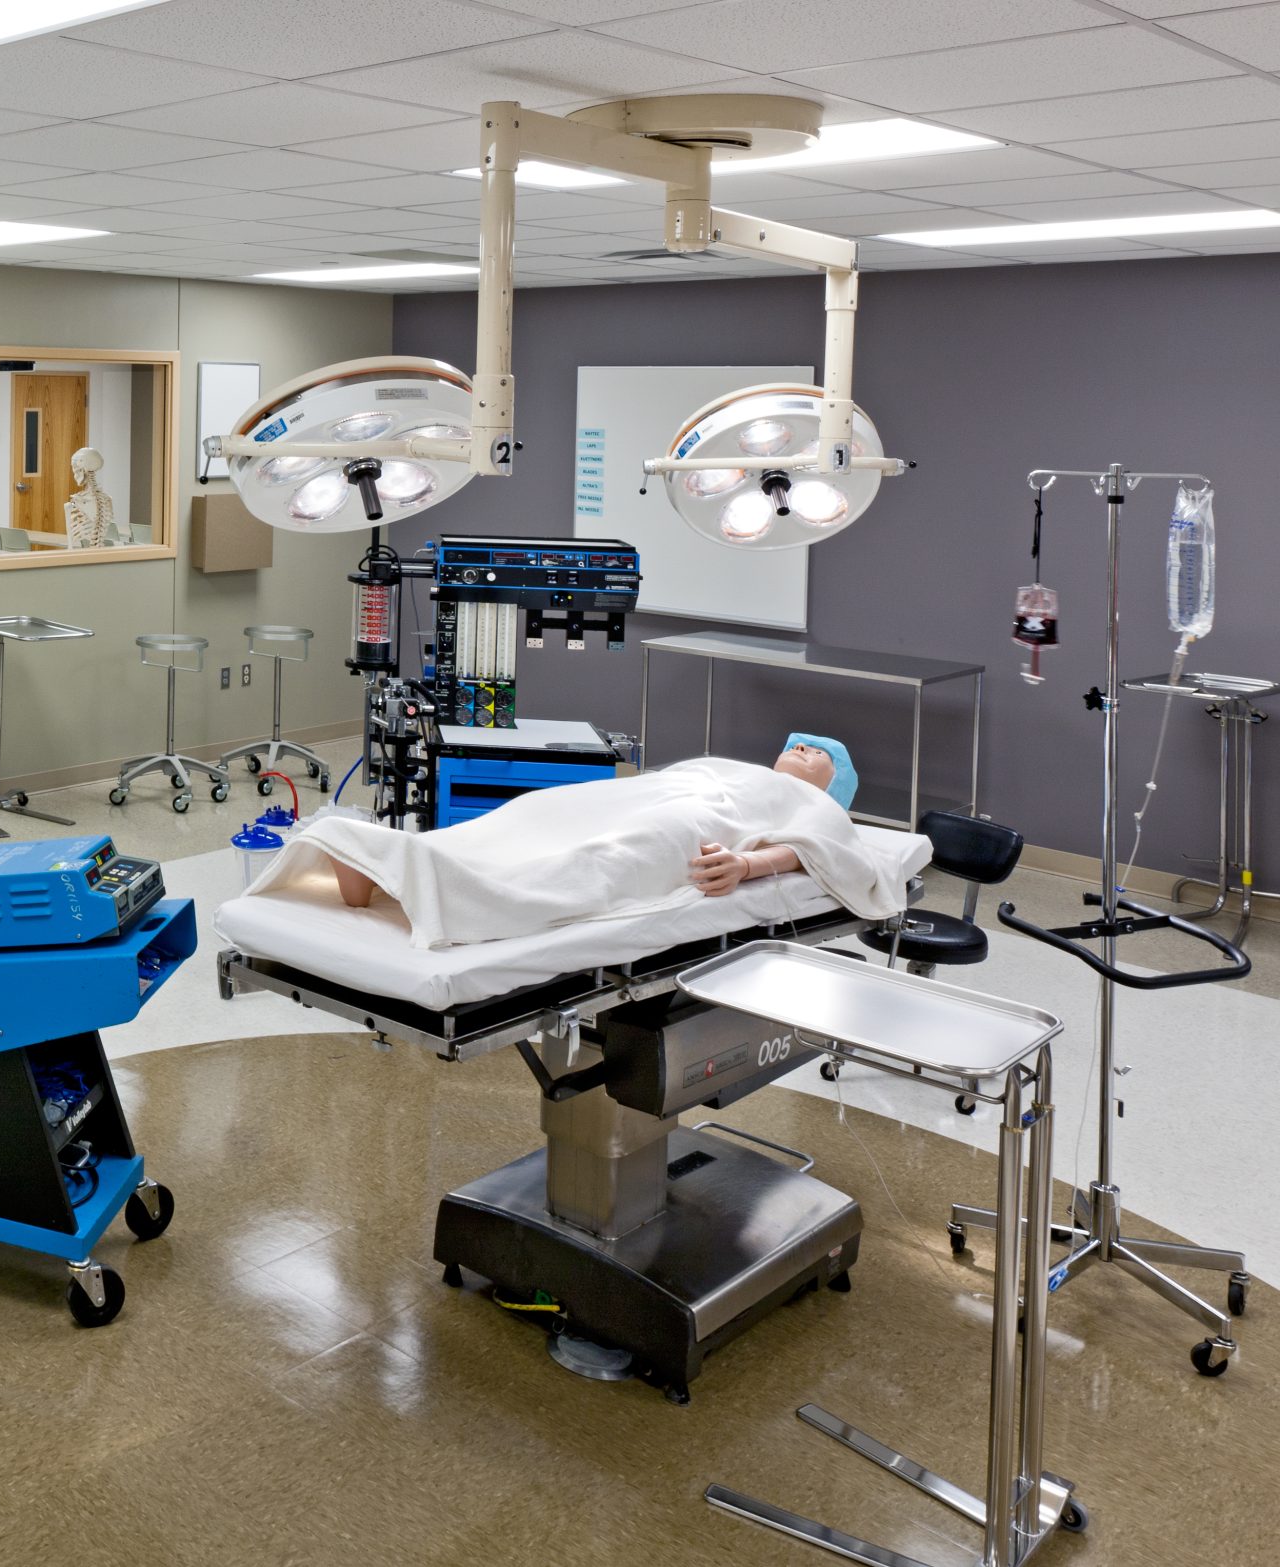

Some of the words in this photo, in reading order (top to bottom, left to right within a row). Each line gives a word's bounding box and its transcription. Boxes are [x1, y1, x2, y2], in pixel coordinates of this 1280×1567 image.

[497, 442, 510, 463] 2
[836, 449, 844, 465] 1
[757, 1034, 792, 1066] 005
